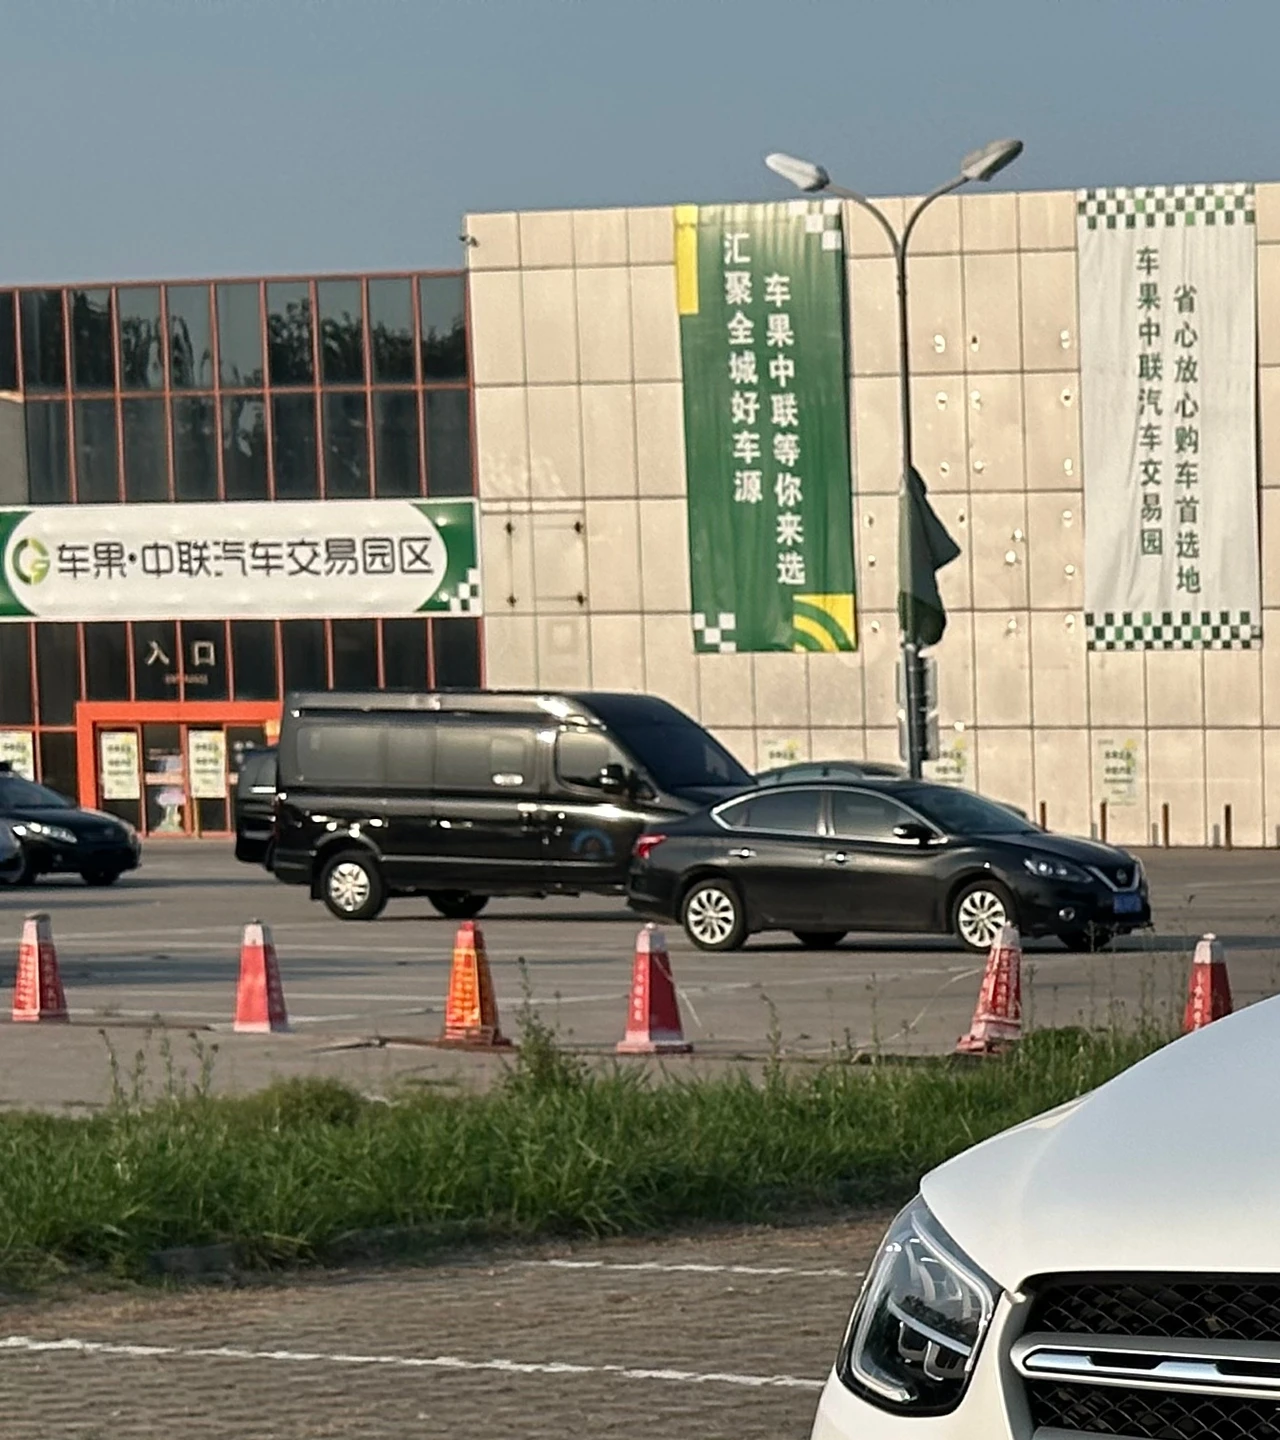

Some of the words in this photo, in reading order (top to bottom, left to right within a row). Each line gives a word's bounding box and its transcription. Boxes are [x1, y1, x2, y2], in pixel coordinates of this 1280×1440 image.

[723, 232, 763, 504] 汇聚全城好车源
[763, 272, 806, 585] 车果中联等你来选
[1136, 246, 1164, 556] 车果中联汽车交易园
[1173, 284, 1202, 594] 省心放心购车首选地
[57, 536, 434, 580] 车果·中联汽车交易园区
[146, 640, 216, 666] 入口
